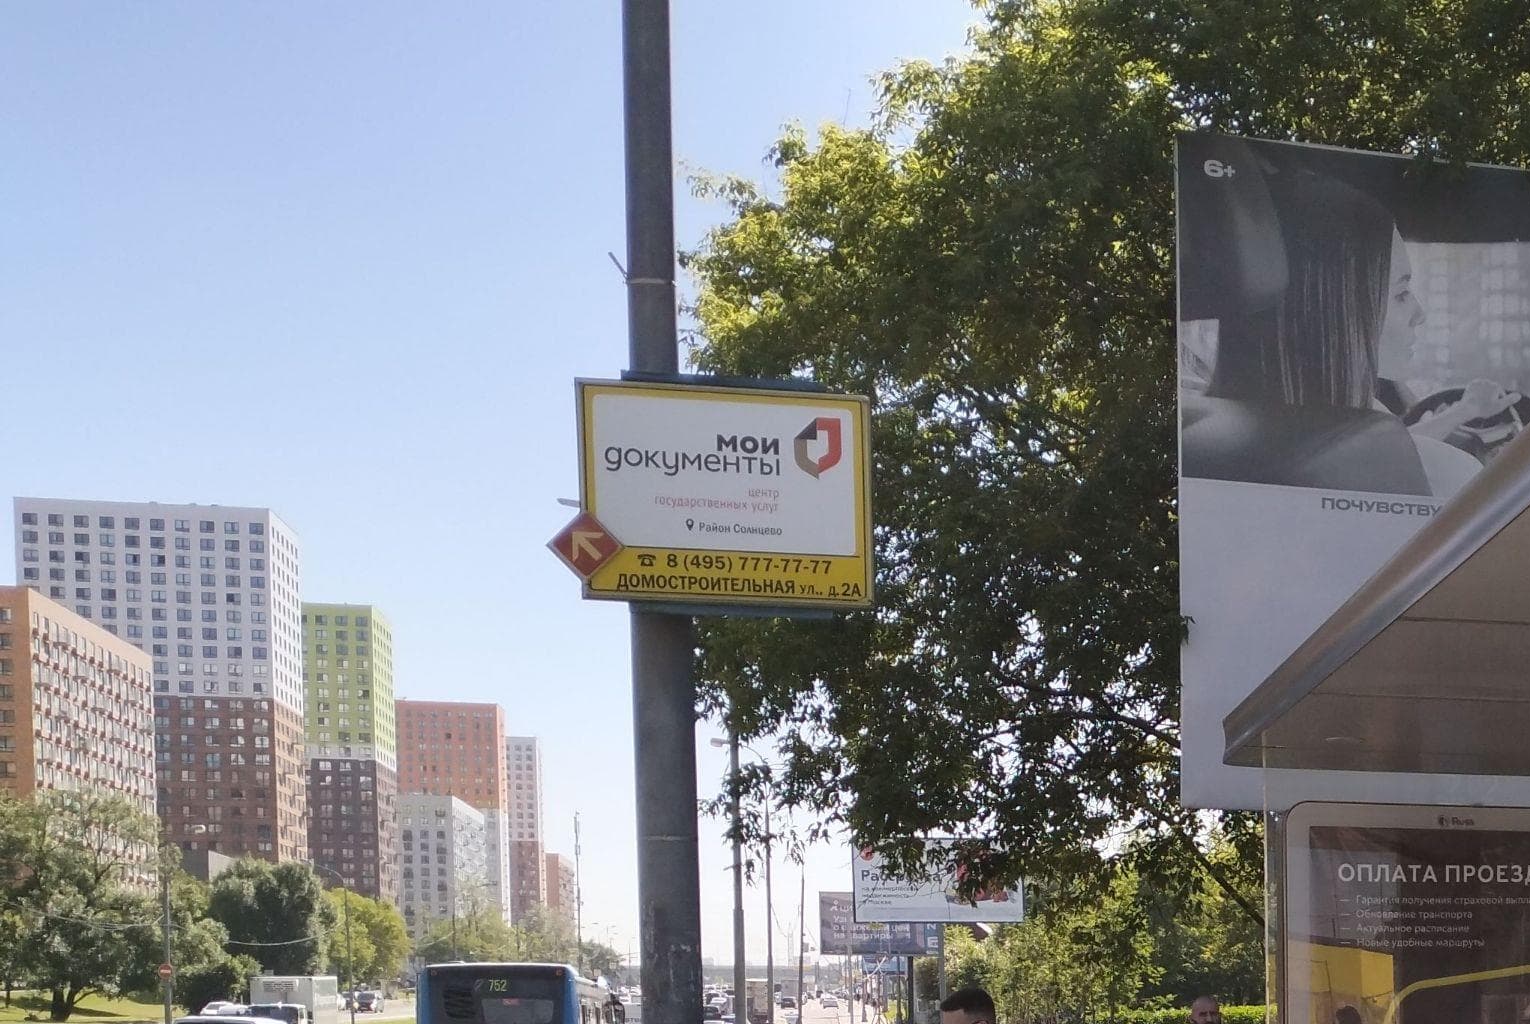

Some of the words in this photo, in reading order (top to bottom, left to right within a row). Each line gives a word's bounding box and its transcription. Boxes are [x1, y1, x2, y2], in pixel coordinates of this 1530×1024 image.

[1204, 160, 1235, 177] 6+
[716, 433, 780, 456] мои
[604, 446, 780, 477] документы
[654, 495, 747, 510] государственных
[751, 501, 779, 513] услуг
[748, 488, 780, 501] центр
[699, 521, 731, 533] Район
[733, 523, 783, 536] Солнцево
[666, 553, 678, 568] 8
[683, 554, 733, 573] (495)
[739, 556, 832, 574] 777-77-77
[617, 573, 795, 594] ДОМОСТРОИТЕЛЬНАЯ
[1337, 863, 1438, 884] ОПЛАТА
[488, 979, 507, 992] 752
